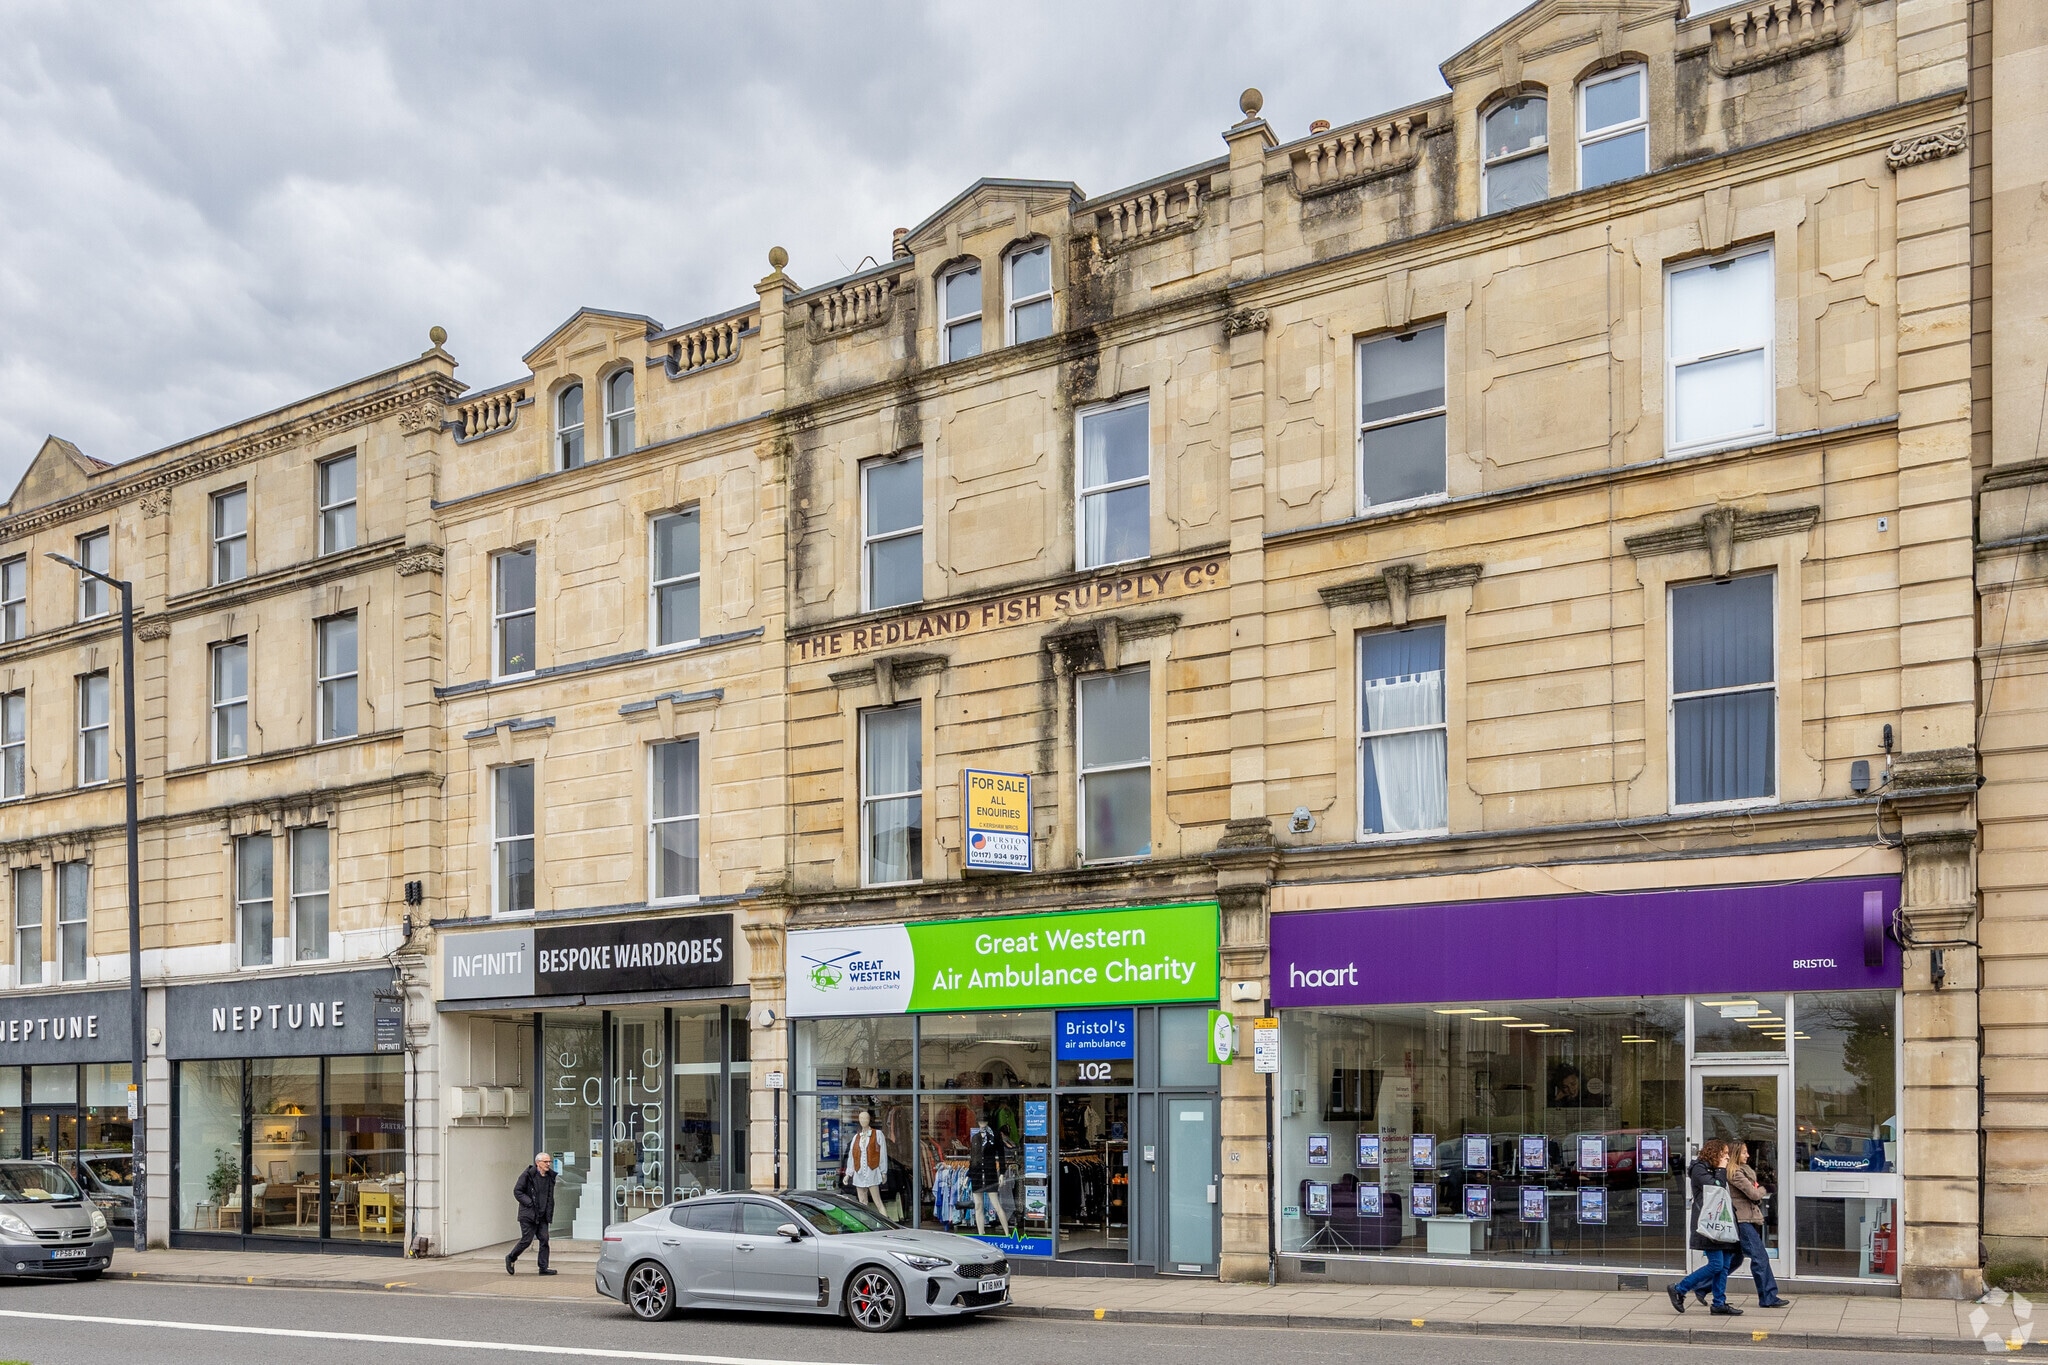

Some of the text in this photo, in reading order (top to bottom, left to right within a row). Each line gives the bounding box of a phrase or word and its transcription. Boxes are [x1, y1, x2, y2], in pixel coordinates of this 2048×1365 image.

[796, 633, 842, 660] THE
[853, 609, 970, 650] REDLAND
[982, 595, 1041, 627] FISH
[1054, 570, 1172, 611] SUPPLY
[971, 777, 1025, 793] FOR SALE
[990, 796, 1006, 806] ALL
[976, 807, 1021, 819] ENQUIRIES
[987, 836, 1027, 845] BURSTON
[994, 843, 1019, 851] COOK
[971, 850, 1027, 861] (0117) 934 9977
[975, 928, 1146, 955] Great Western
[539, 945, 610, 973] BESPOKE
[613, 937, 723, 969] WARDROBES
[849, 959, 884, 972] GREAT
[1792, 958, 1838, 969] BRISTOL
[849, 970, 901, 983] WESTERN
[932, 955, 1197, 991] Air Ambulance Charity
[1290, 961, 1359, 988] haart
[212, 1001, 344, 1032] NEPTUNE
[1066, 1019, 1126, 1035] Bristol's
[1065, 1038, 1127, 1049] air ambulance
[1078, 1062, 1112, 1080] 102
[552, 1052, 577, 1108] the
[582, 1069, 639, 1107] art
[641, 1048, 663, 1177] space
[613, 1111, 639, 1143] of
[1706, 1222, 1733, 1233] NEXT
[1000, 1242, 1014, 1251] days
